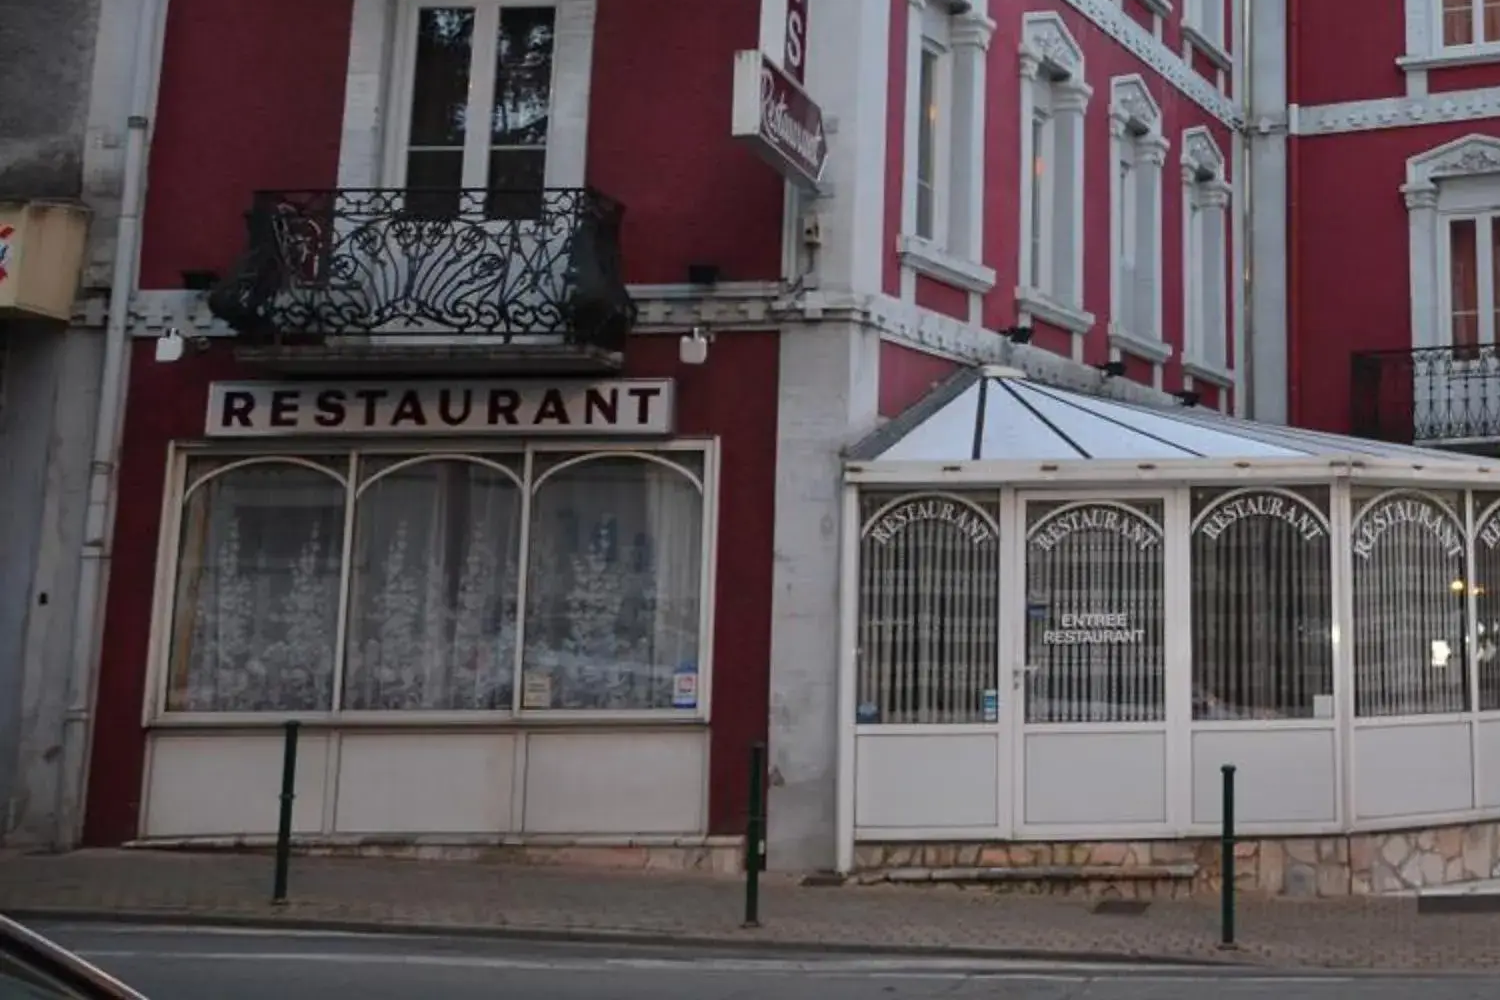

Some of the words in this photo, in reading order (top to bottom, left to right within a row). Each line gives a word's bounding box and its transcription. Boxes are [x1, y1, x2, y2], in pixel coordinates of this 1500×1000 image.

[221, 386, 661, 429] RESTAURANT
[871, 500, 992, 546] RESTAURANT
[1035, 507, 1157, 552] RESTAURANT
[1201, 496, 1324, 542] RESTAURANT
[1353, 499, 1464, 561] RESTAURANT
[1043, 629, 1145, 645] RESTAURANT
